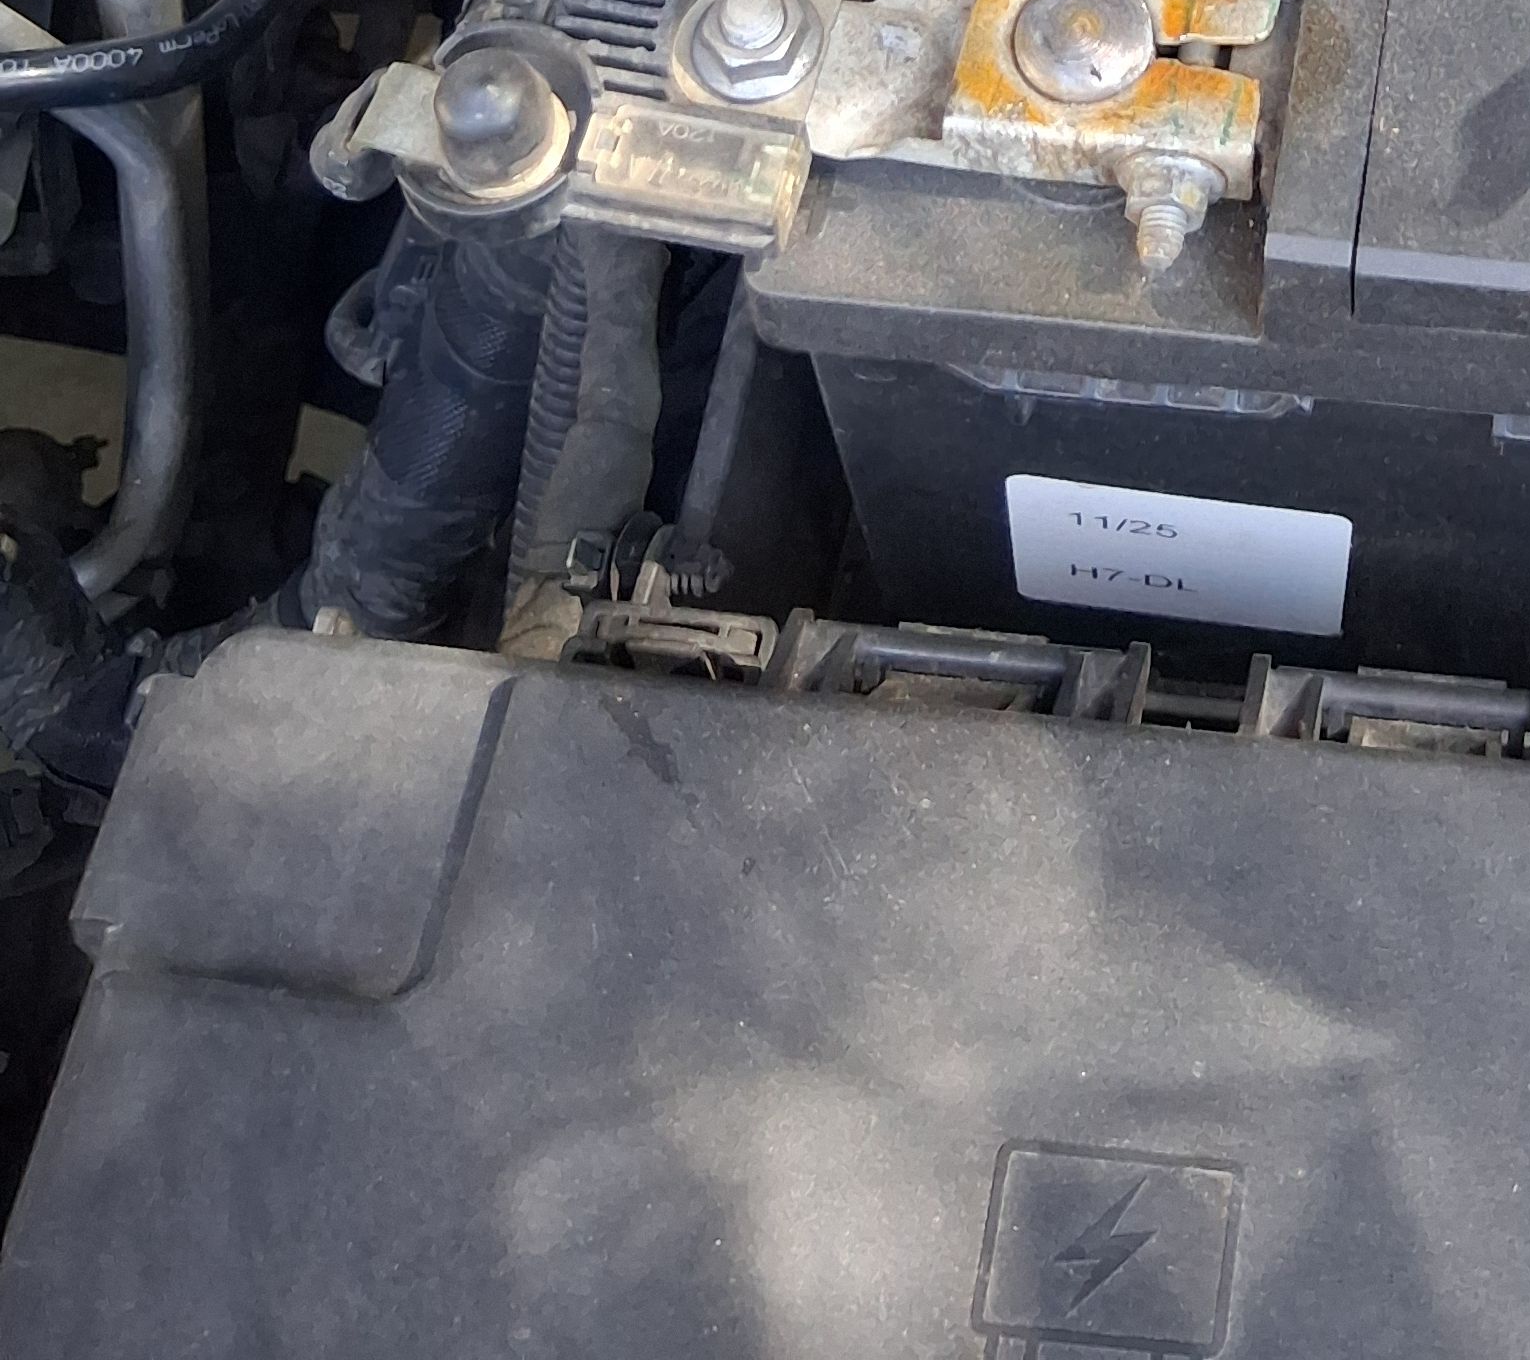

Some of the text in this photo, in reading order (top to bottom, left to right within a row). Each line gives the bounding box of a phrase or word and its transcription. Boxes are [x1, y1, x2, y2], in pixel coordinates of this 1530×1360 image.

[53, 46, 144, 74] 4000A
[1068, 511, 1179, 540] 11/25
[1070, 562, 1199, 593] H7-DL
